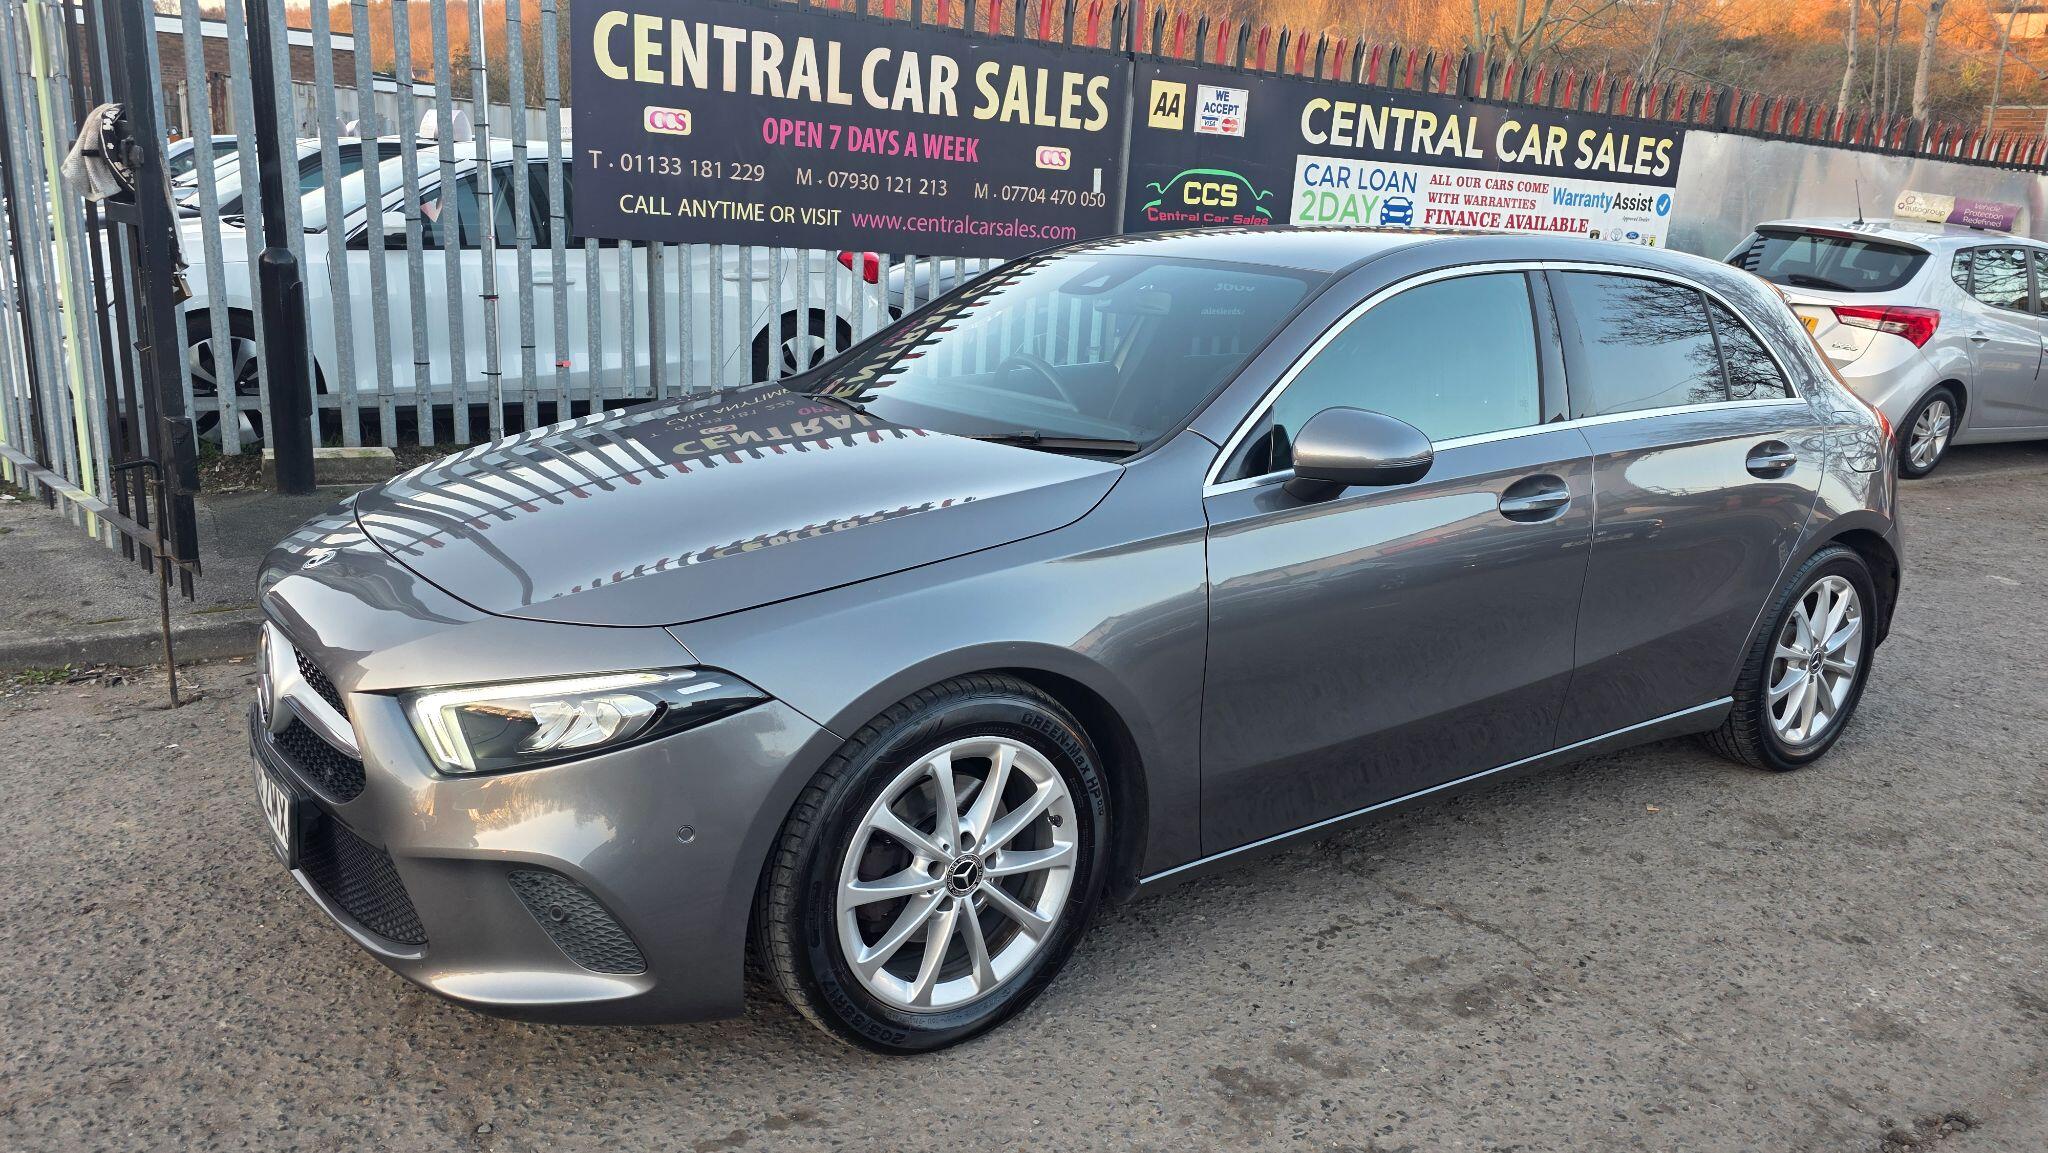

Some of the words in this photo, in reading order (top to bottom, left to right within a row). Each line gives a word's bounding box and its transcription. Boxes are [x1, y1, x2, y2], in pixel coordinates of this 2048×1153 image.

[593, 10, 853, 107] CENTRAL
[861, 46, 960, 118] CAR
[973, 61, 1111, 132] SALES
[1153, 91, 1181, 118] AA
[1216, 89, 1230, 102] WE
[1203, 101, 1240, 116] ACCEPT
[650, 110, 687, 131] CCS
[1204, 119, 1216, 127] VISA
[762, 117, 823, 148] OPEN
[829, 124, 842, 150] 7
[847, 125, 900, 156] DAYS
[904, 131, 918, 158] A
[923, 132, 980, 163] WEEK
[1301, 97, 1484, 159] CENTRAL
[1496, 119, 1568, 167] CAR
[1574, 126, 1673, 178] SALES
[620, 153, 682, 176] 01133
[690, 159, 722, 179] 181
[729, 162, 765, 182] 229
[1040, 149, 1067, 167] CCS
[827, 170, 880, 191] 07930
[886, 176, 911, 194] 121
[918, 178, 948, 196] 213
[1304, 163, 1351, 189] CAR
[1357, 167, 1418, 194] LOAN
[1430, 174, 1453, 187] ALL
[1456, 175, 1482, 189] OUR
[1485, 178, 1514, 192] CARS
[1516, 180, 1550, 195] COME
[1001, 185, 1046, 203] 07704
[1050, 189, 1077, 206] 470
[1080, 191, 1106, 208] 050
[1183, 181, 1239, 207] CCS
[1427, 191, 1459, 205] WITH
[1463, 194, 1537, 210] WARRANTIES
[619, 194, 671, 216] CALL
[678, 198, 765, 222] ANYTIME
[770, 205, 796, 224] OR
[800, 207, 842, 226] VISIT
[852, 212, 1077, 240] www.centralcarsales.com
[1147, 207, 1200, 222] Central
[1203, 213, 1230, 223] Car
[1233, 214, 1270, 226] Sales
[1299, 189, 1380, 224] 2DAY
[1904, 203, 1947, 217] autogroup
[1963, 209, 2004, 221] Protection
[1424, 208, 1501, 229] FINANCE
[1504, 213, 1590, 234] AVAILABLE
[1962, 216, 2002, 228] Redefined
